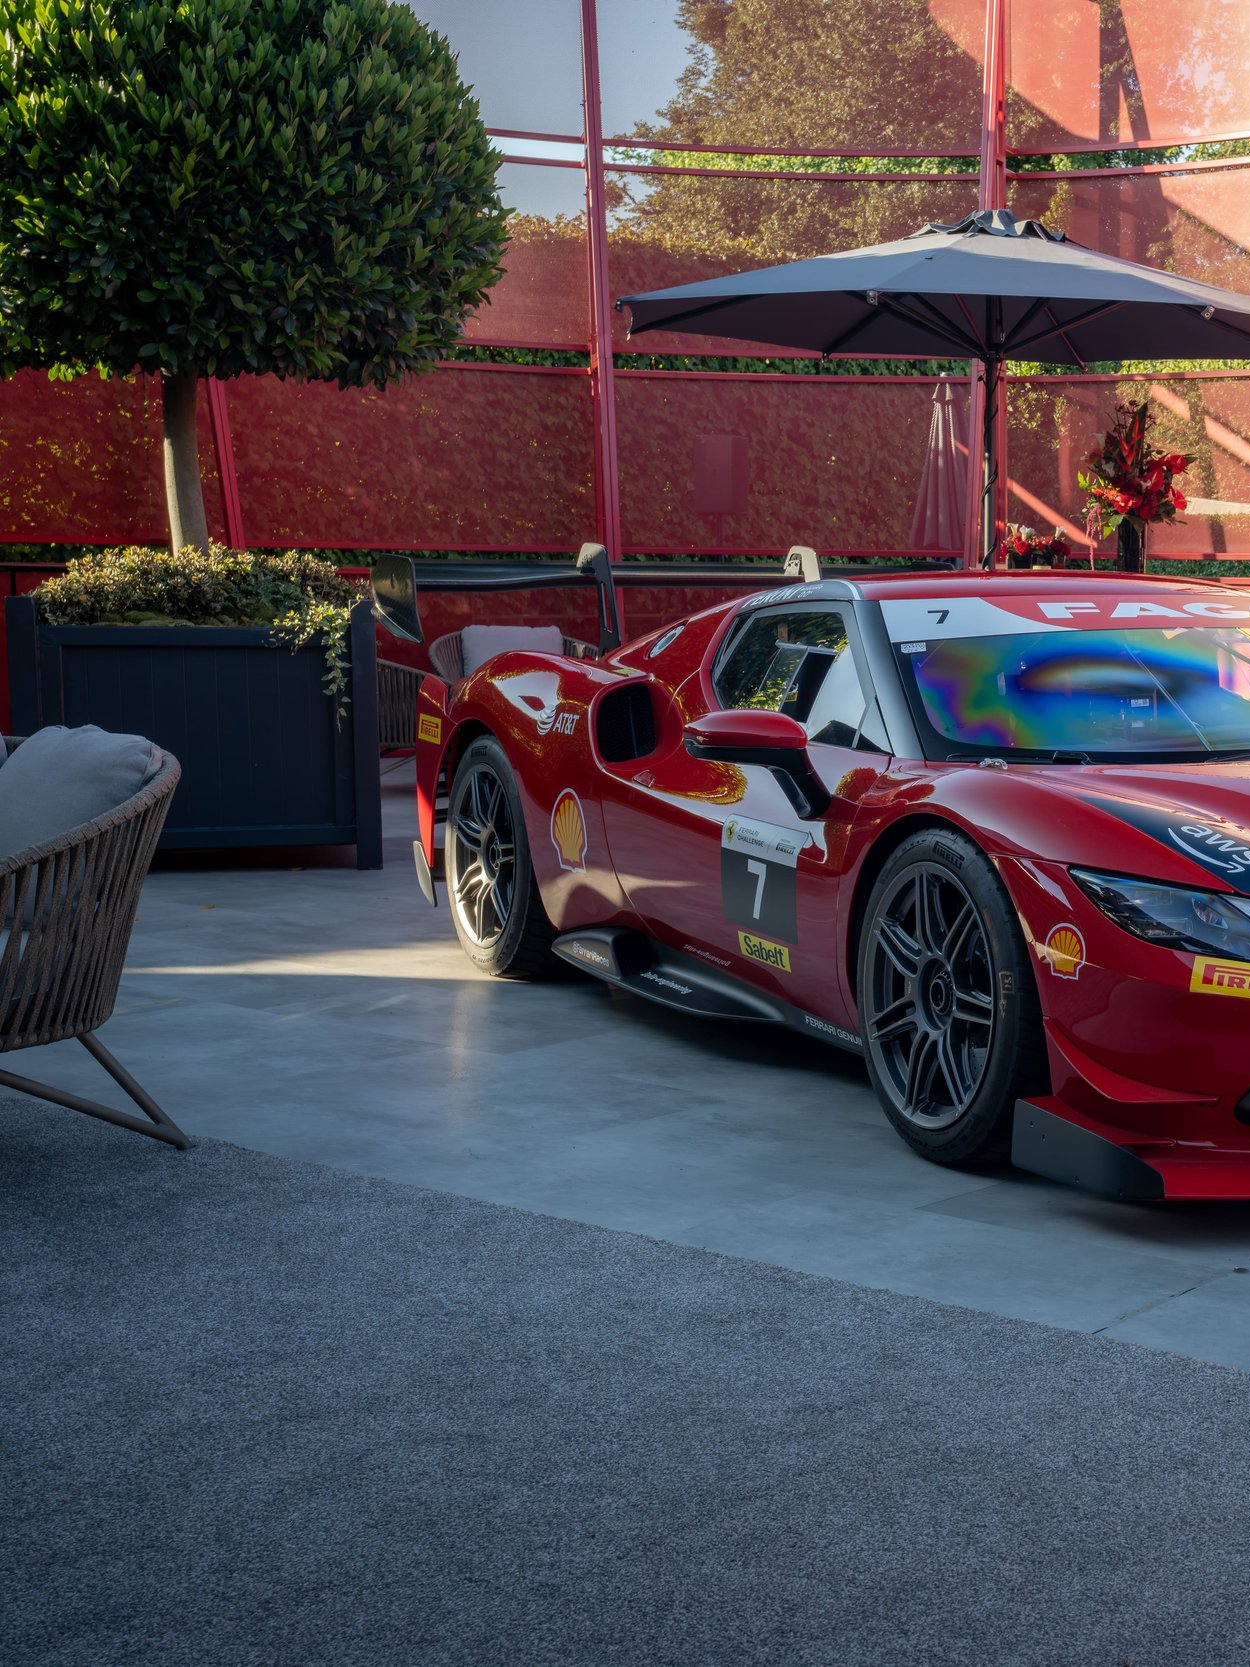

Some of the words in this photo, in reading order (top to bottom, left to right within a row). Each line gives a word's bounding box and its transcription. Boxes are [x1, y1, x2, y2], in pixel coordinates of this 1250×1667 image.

[927, 609, 950, 625] 7
[421, 719, 439, 738] PIRELLI
[552, 712, 579, 735] AT&T
[736, 834, 764, 848] CHALLENGE
[739, 826, 760, 837] FERRARI
[933, 841, 965, 869] PIRELLI
[747, 858, 767, 920] 7
[743, 935, 785, 968] Sabelt
[805, 1015, 837, 1036] FERRARI
